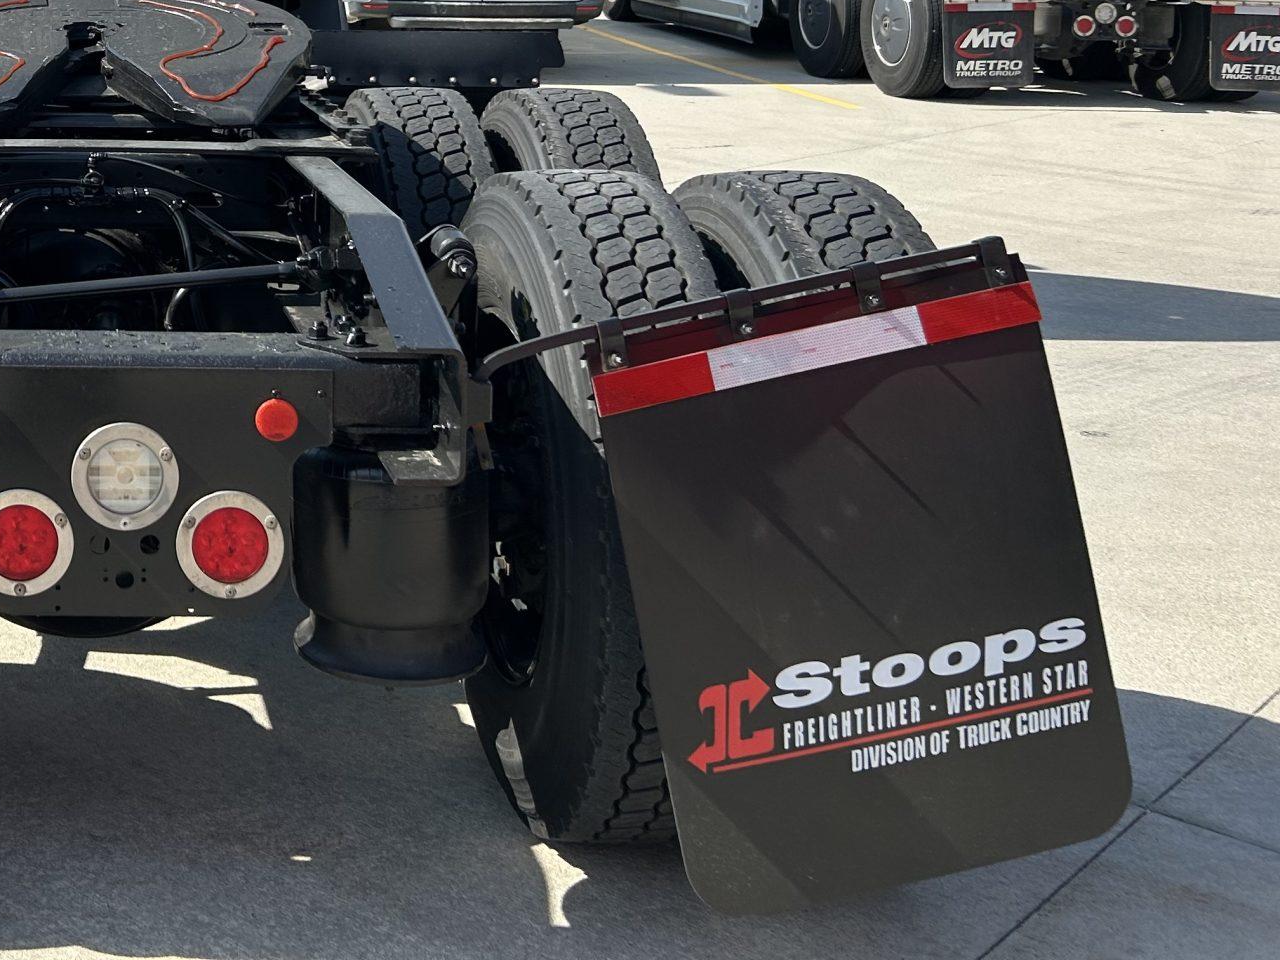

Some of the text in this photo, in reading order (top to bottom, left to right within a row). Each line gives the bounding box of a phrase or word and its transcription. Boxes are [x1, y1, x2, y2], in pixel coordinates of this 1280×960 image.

[959, 27, 1017, 49] MTG
[1226, 31, 1280, 53] MTG
[955, 60, 1023, 71] METRO
[1221, 73, 1253, 81] TRUCK
[772, 616, 1087, 709] Stoops
[782, 659, 1089, 750] FREIGHTLINER WESTERN STAR
[851, 698, 1091, 773] DIVISION OF TRUCK COUNTRY
